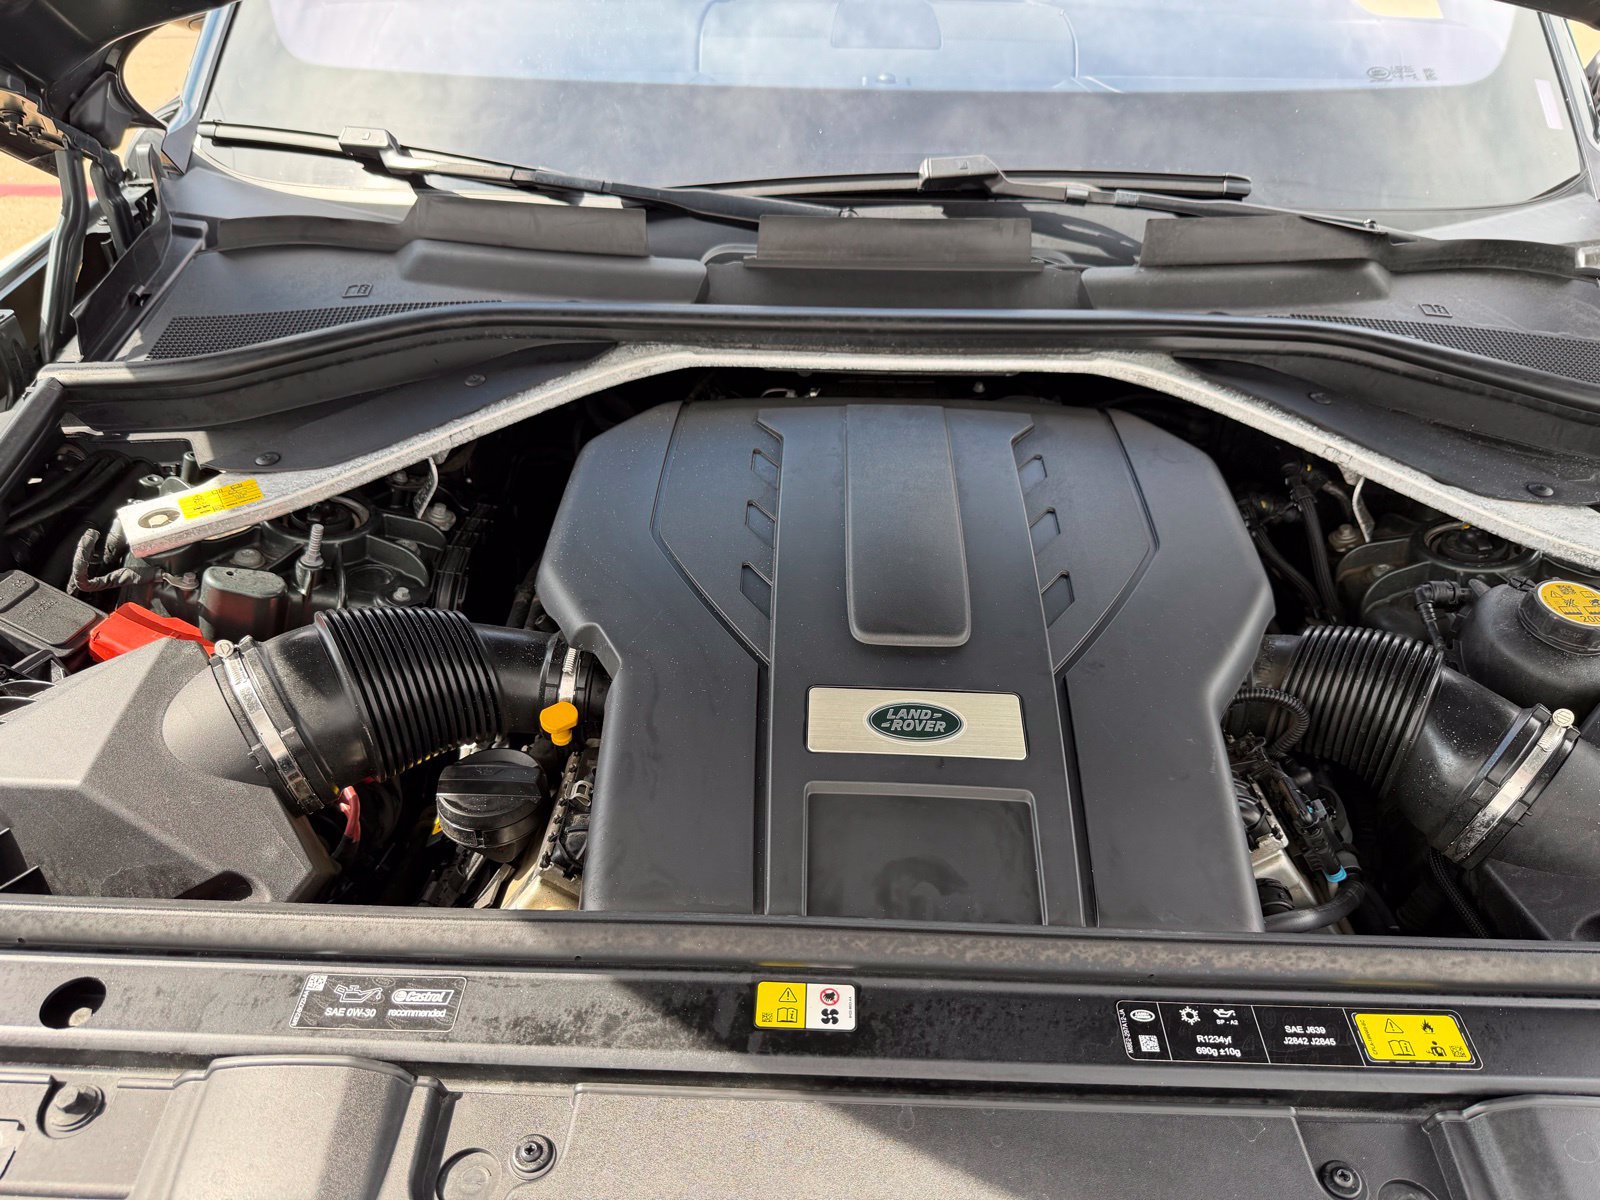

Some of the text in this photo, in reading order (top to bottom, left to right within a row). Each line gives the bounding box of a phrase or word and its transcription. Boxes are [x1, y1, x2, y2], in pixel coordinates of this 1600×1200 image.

[887, 709, 932, 719] LAND
[891, 719, 946, 732] ROVER
[406, 991, 445, 1003] Castrol
[324, 1007, 377, 1017] SAE 0W-30
[387, 1008, 447, 1018] recommended
[1284, 1025, 1326, 1035] SAE J639
[1196, 1034, 1232, 1044] R1234yf
[1283, 1036, 1336, 1046] J2842 J2845
[1195, 1046, 1241, 1057] 690g ±10g
